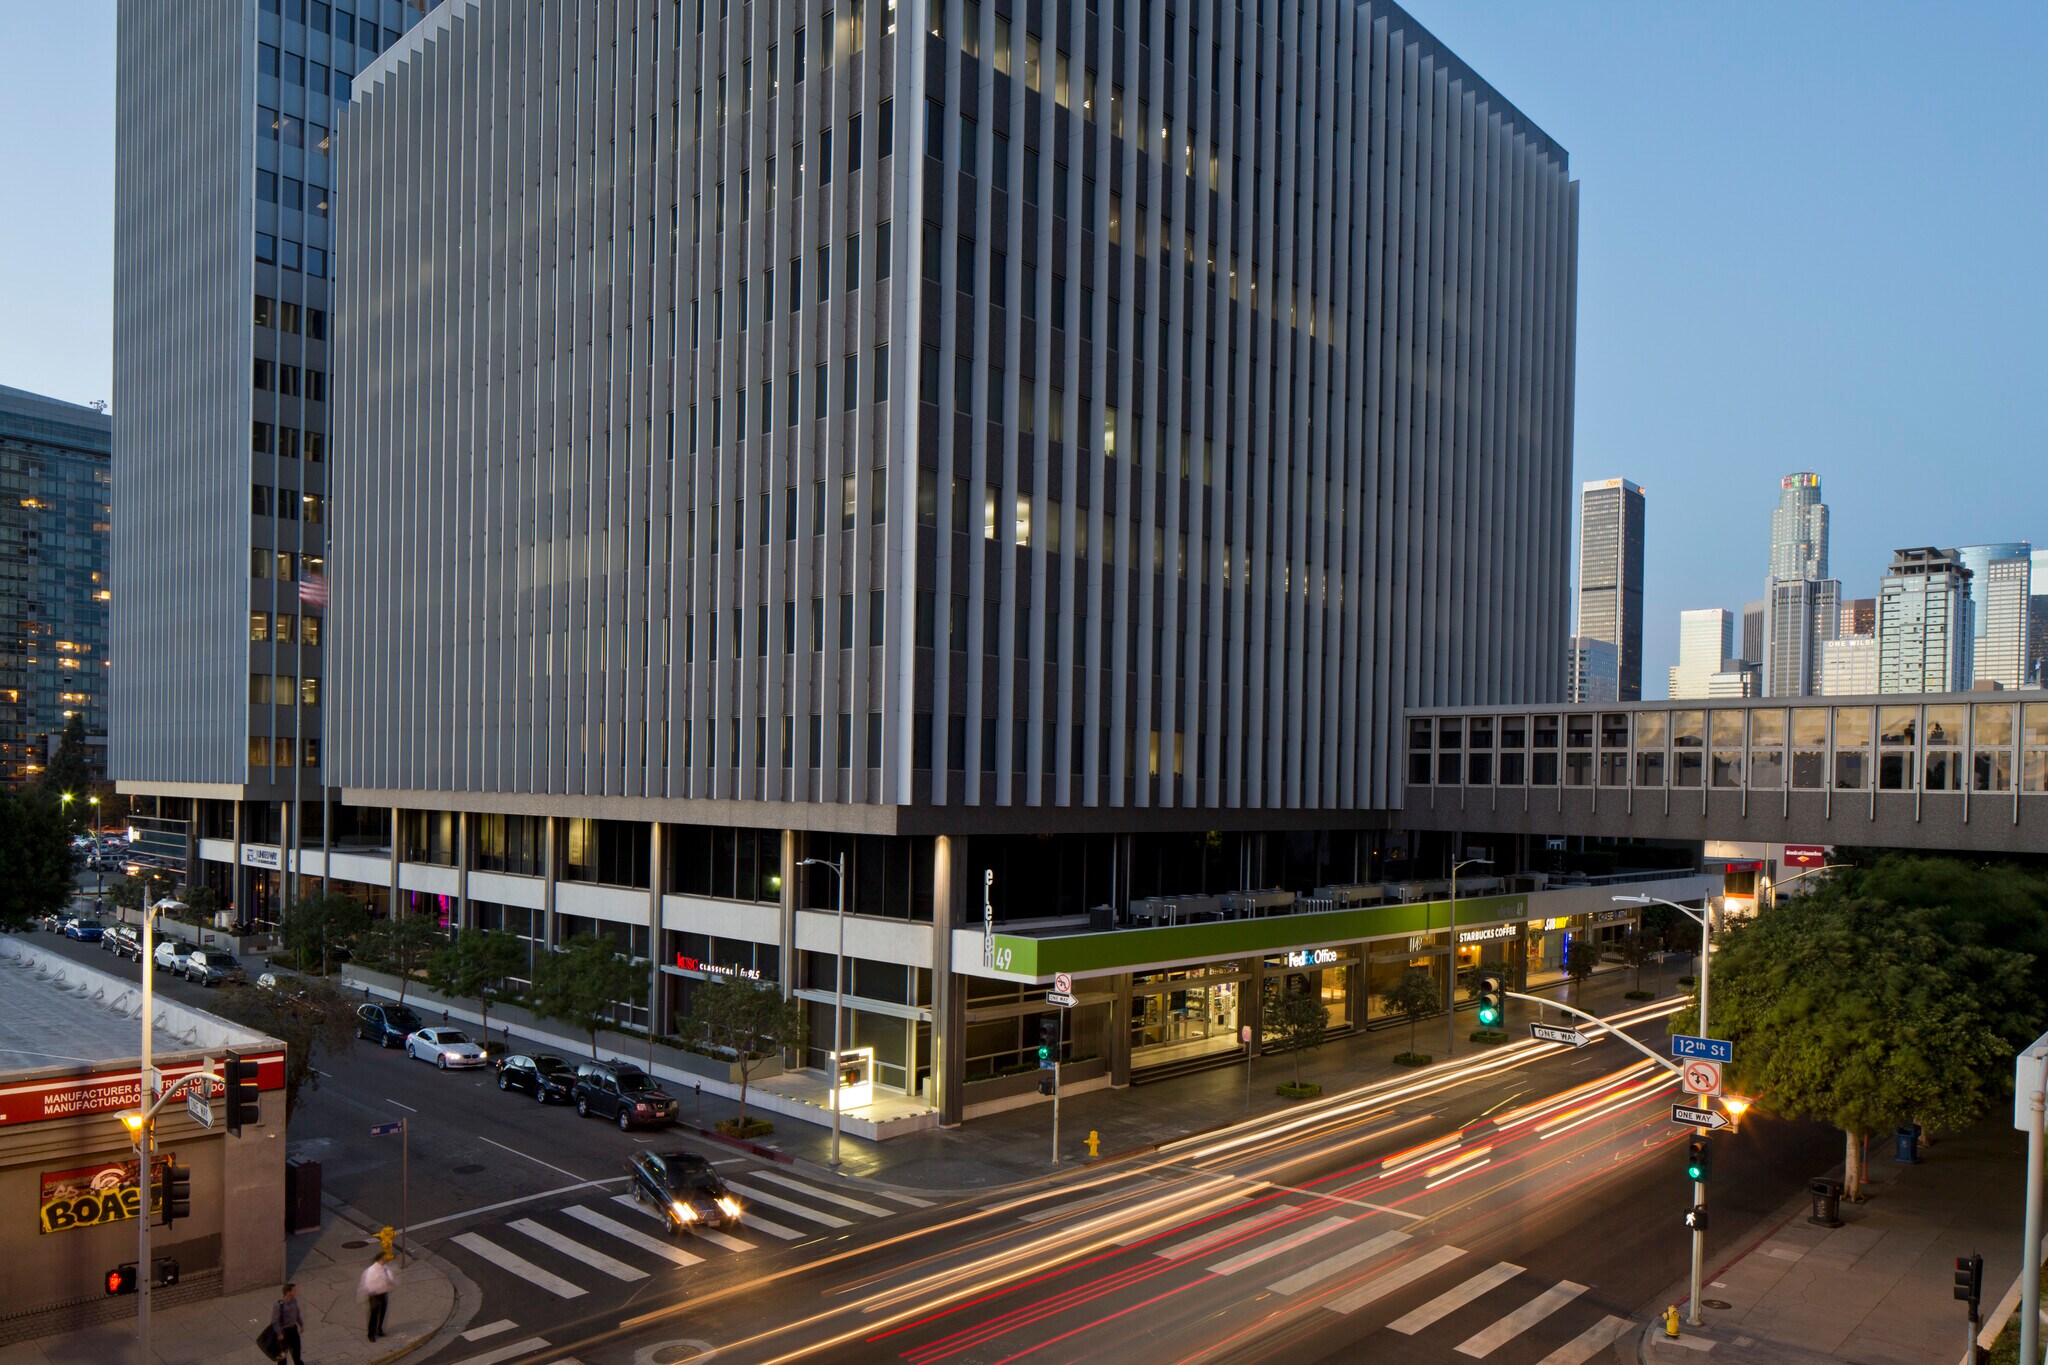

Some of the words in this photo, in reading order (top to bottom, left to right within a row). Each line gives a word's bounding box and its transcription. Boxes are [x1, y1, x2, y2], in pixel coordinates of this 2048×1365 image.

[984, 869, 994, 968] eleven
[1544, 915, 1569, 931] SUBWAY
[1459, 929, 1495, 943] STARBUCKS
[1494, 925, 1517, 938] COFFEE
[996, 947, 1012, 970] 49
[1314, 948, 1337, 964] Office
[699, 963, 733, 975] CLASSICAL
[1538, 1028, 1556, 1039] ONE
[1561, 1032, 1577, 1043] WAY
[1680, 1038, 1706, 1054] 12th
[1711, 1044, 1725, 1057] St
[44, 1085, 132, 1105] MANUFACTURER
[133, 1083, 142, 1093] &
[1677, 1110, 1694, 1120] ONE
[1695, 1112, 1712, 1123] WAY
